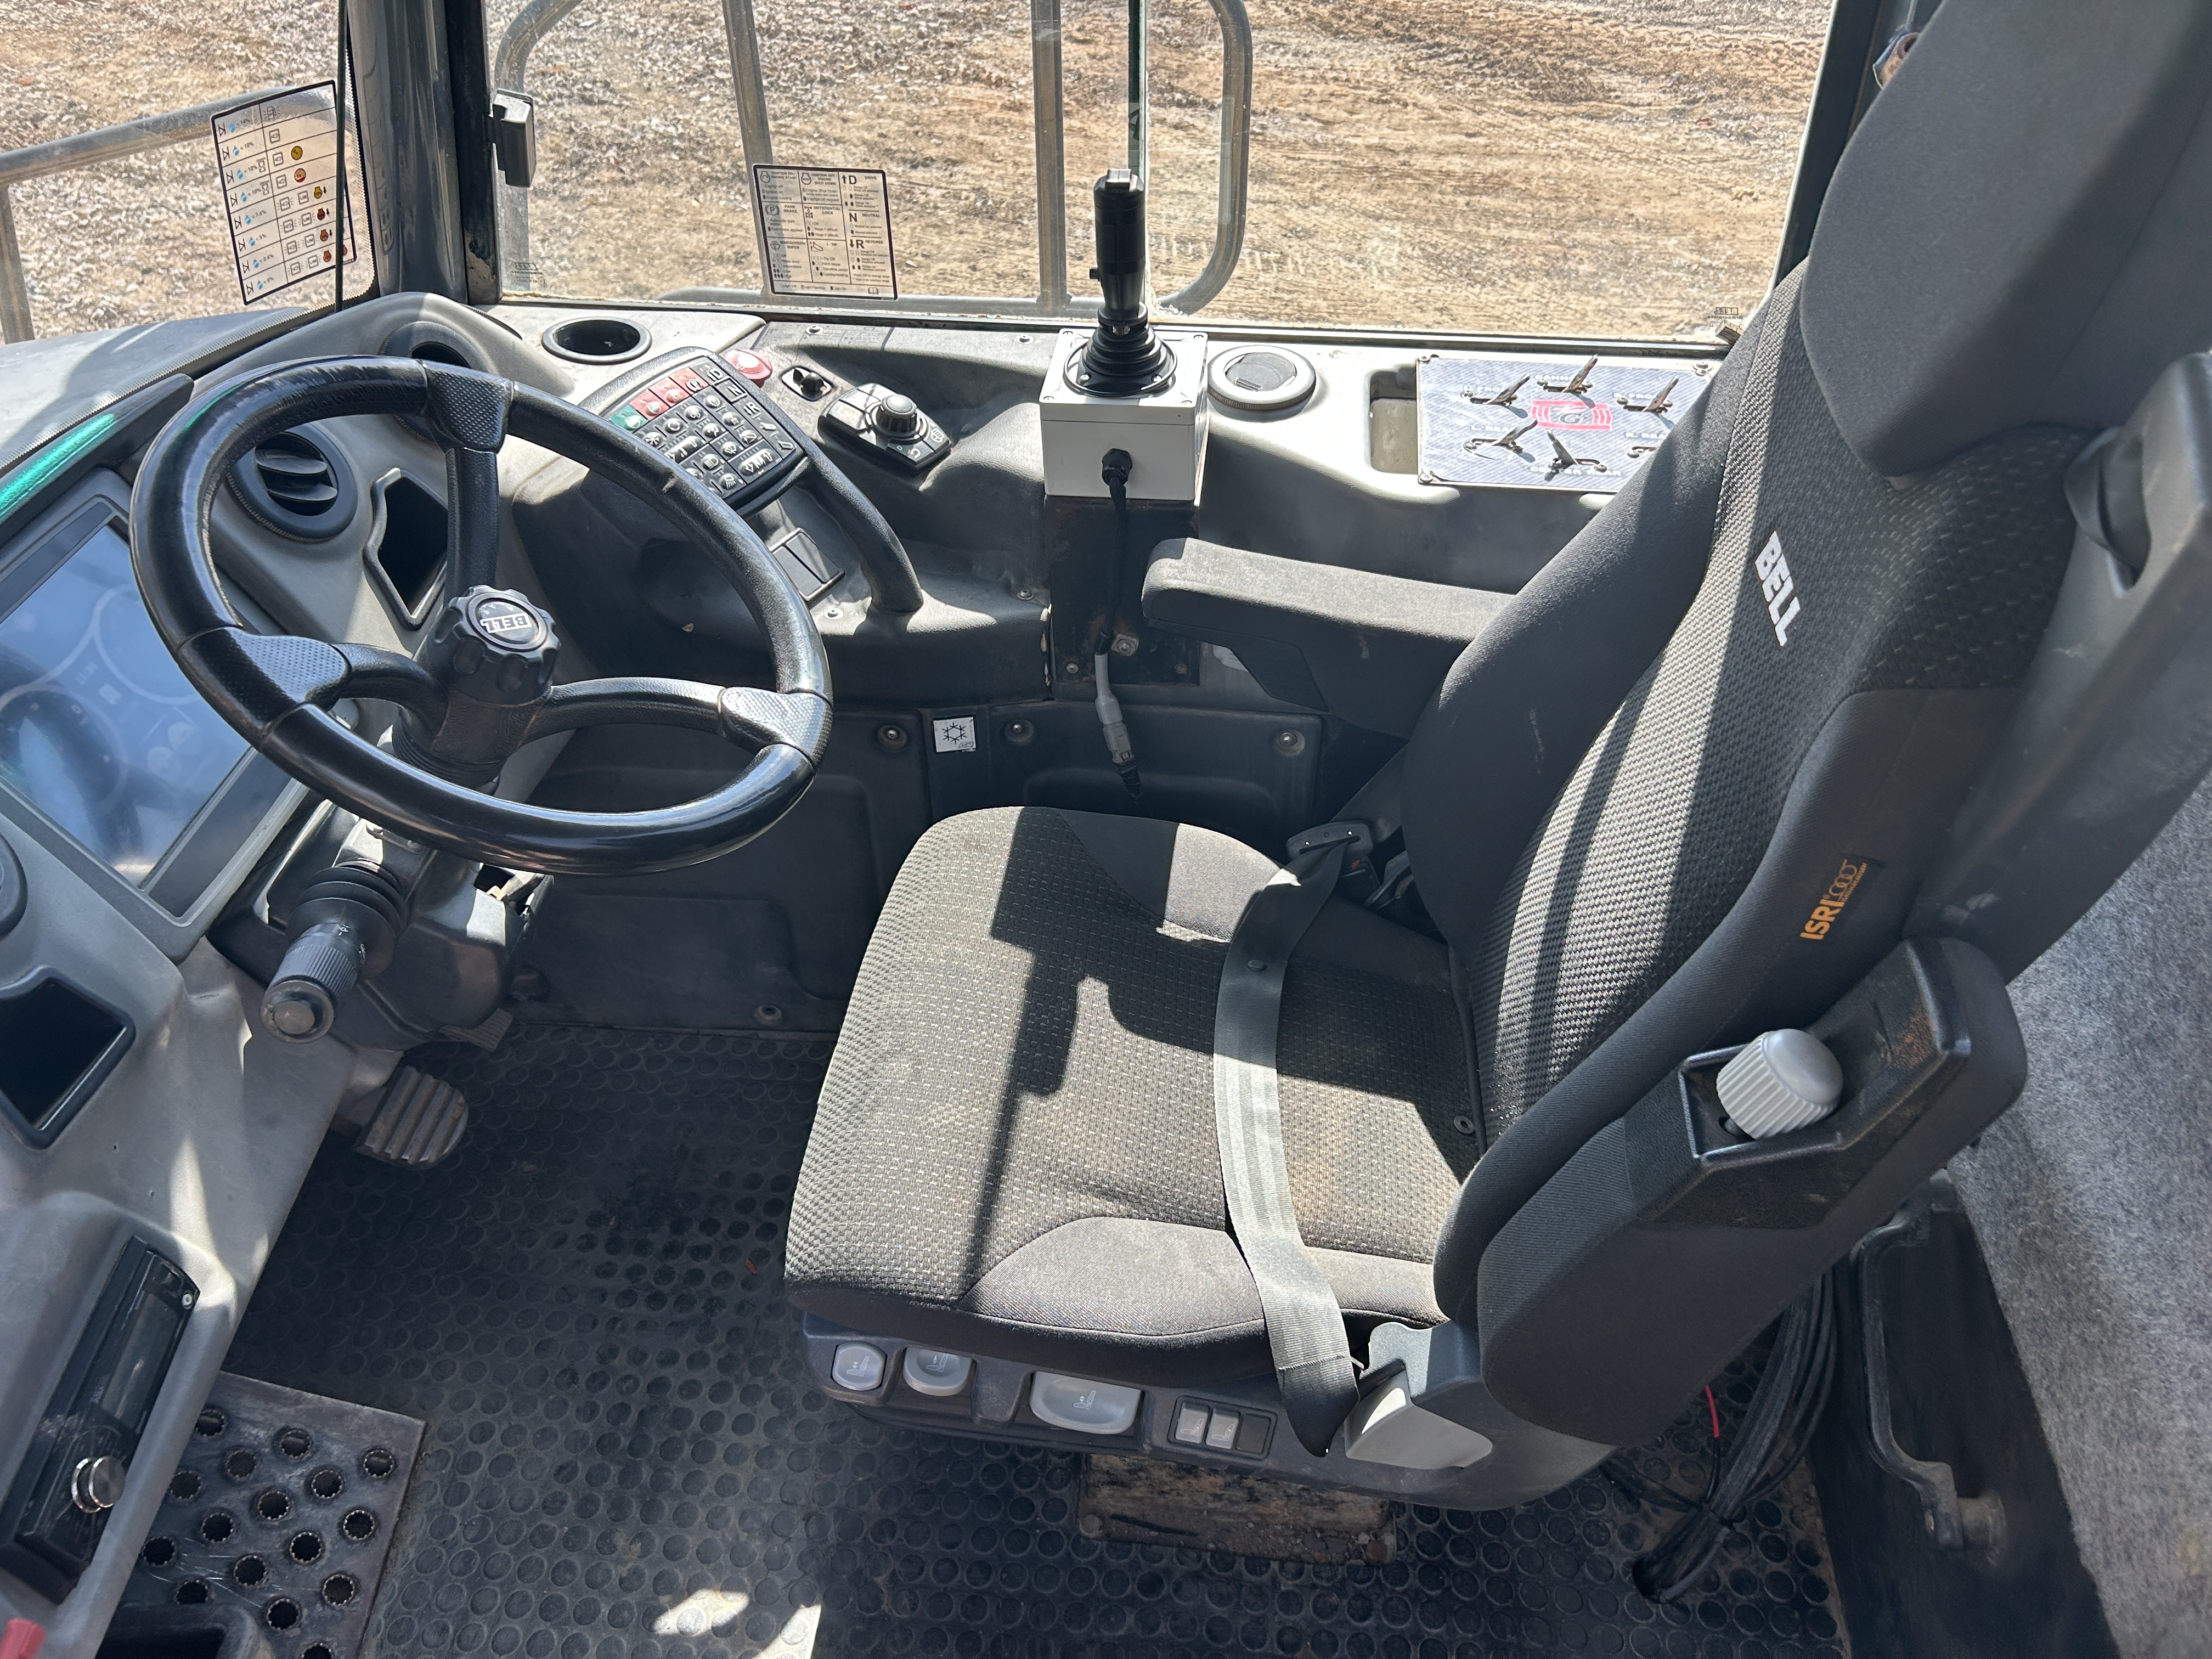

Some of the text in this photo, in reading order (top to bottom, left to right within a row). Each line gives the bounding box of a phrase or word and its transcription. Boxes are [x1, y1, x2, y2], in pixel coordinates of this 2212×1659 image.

[848, 175, 857, 185] D
[849, 212, 857, 222] N
[856, 239, 865, 249] R
[1755, 530, 1801, 647] BELL
[482, 614, 528, 631] BELL
[1799, 898, 1846, 940] ISRI
